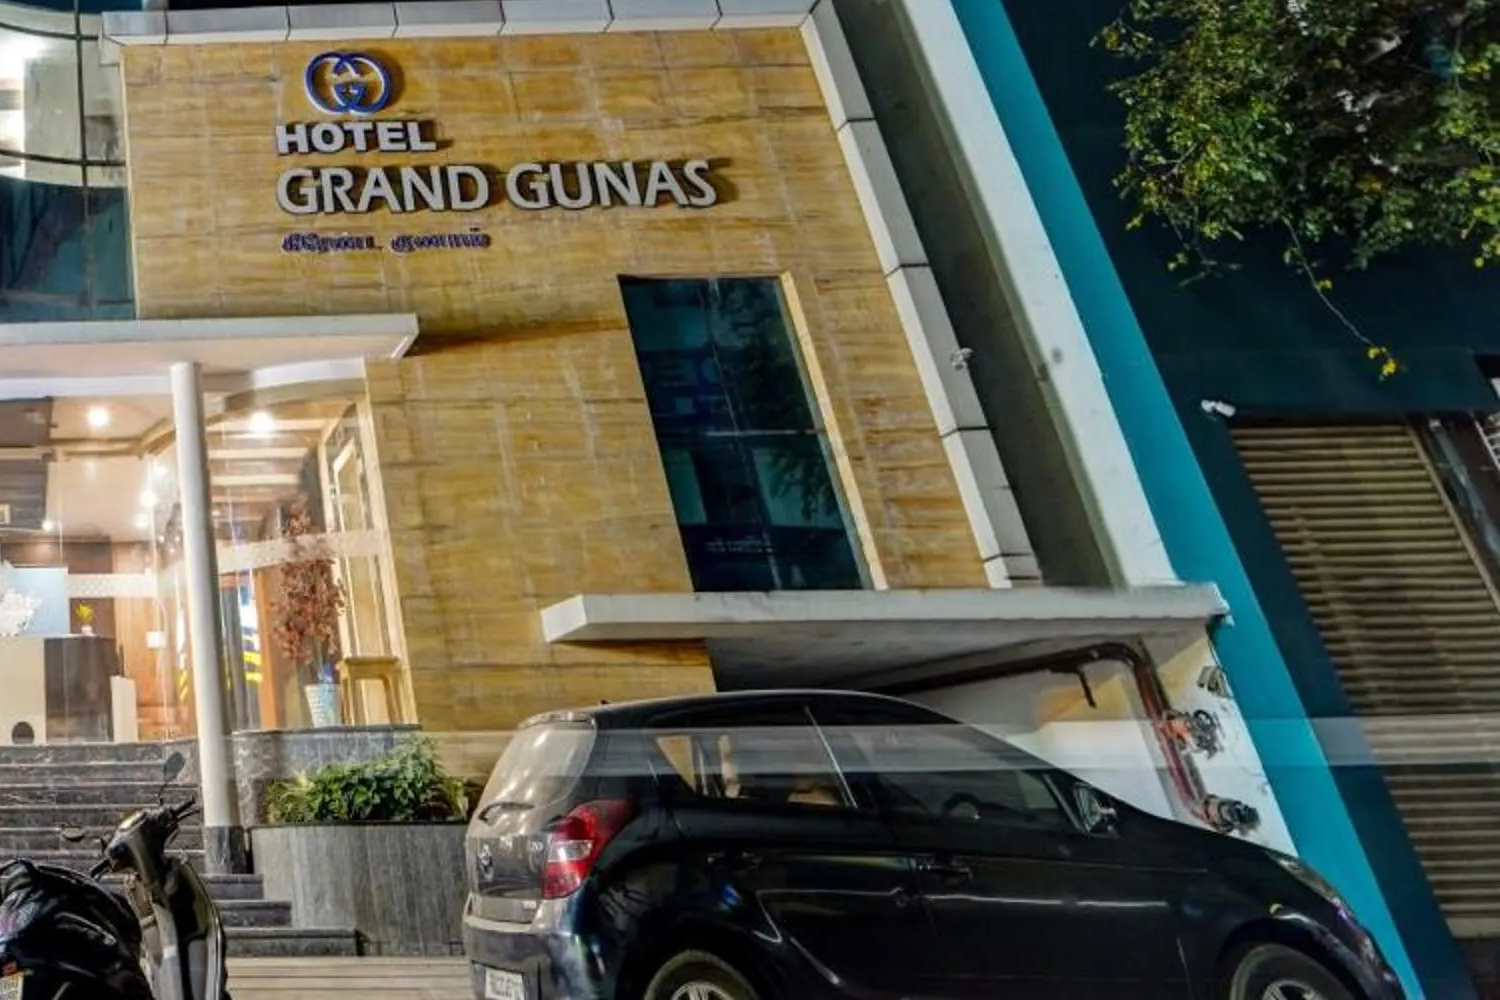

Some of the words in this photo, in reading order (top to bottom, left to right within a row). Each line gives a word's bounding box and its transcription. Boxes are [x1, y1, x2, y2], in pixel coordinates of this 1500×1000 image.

[276, 121, 437, 154] HOTEL
[276, 164, 490, 214] GRAND
[505, 159, 718, 211] GUNAS
